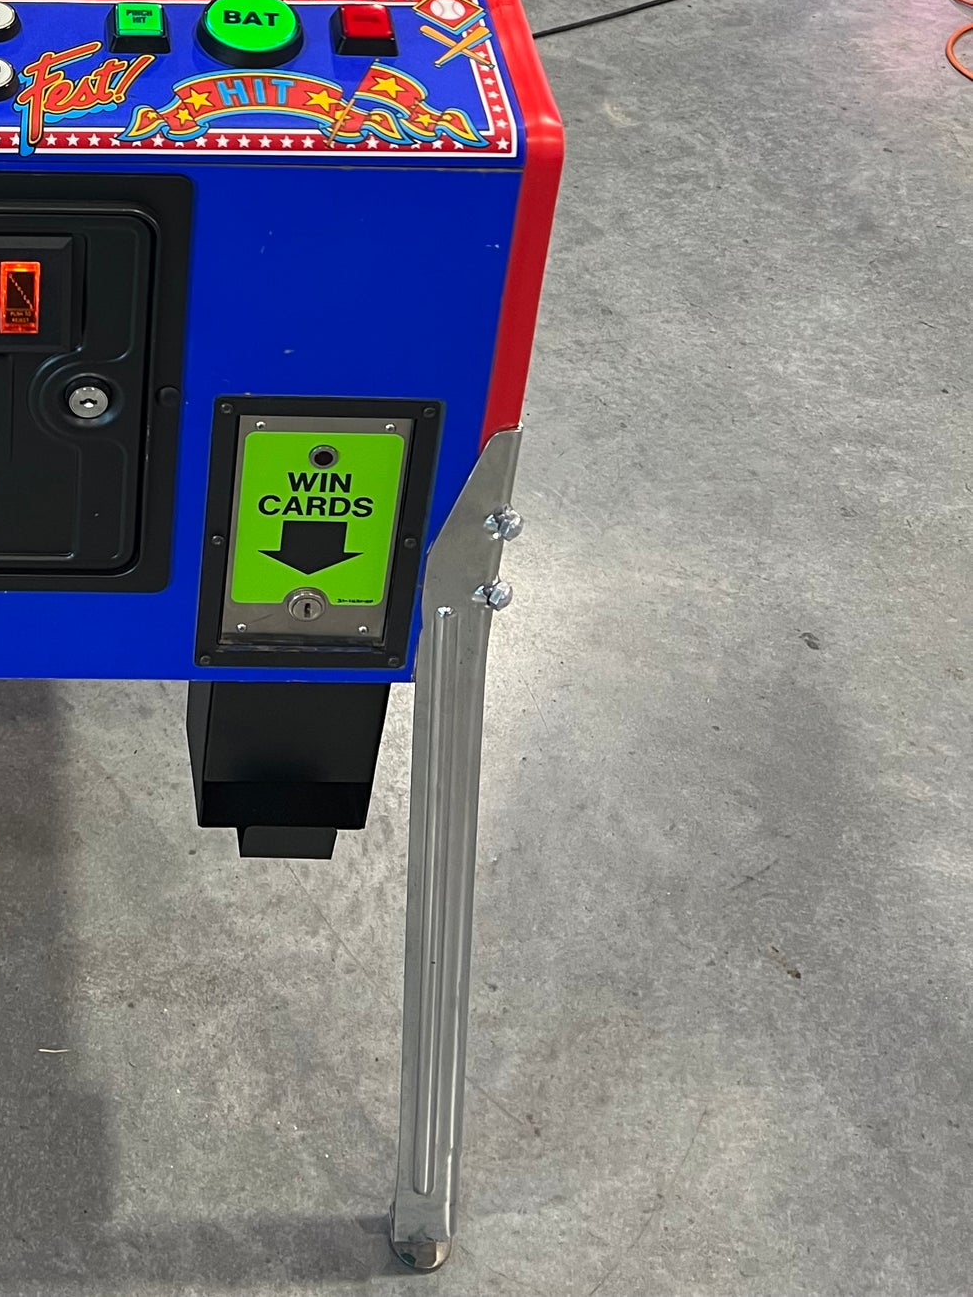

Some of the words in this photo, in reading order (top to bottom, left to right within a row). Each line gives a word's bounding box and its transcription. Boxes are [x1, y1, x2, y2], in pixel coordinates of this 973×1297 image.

[132, 16, 148, 24] HIT
[222, 9, 280, 27] BAT
[13, 42, 156, 156] Fest!
[216, 77, 296, 107] HIT
[287, 471, 352, 494] WIN
[258, 494, 374, 519] CARDS
